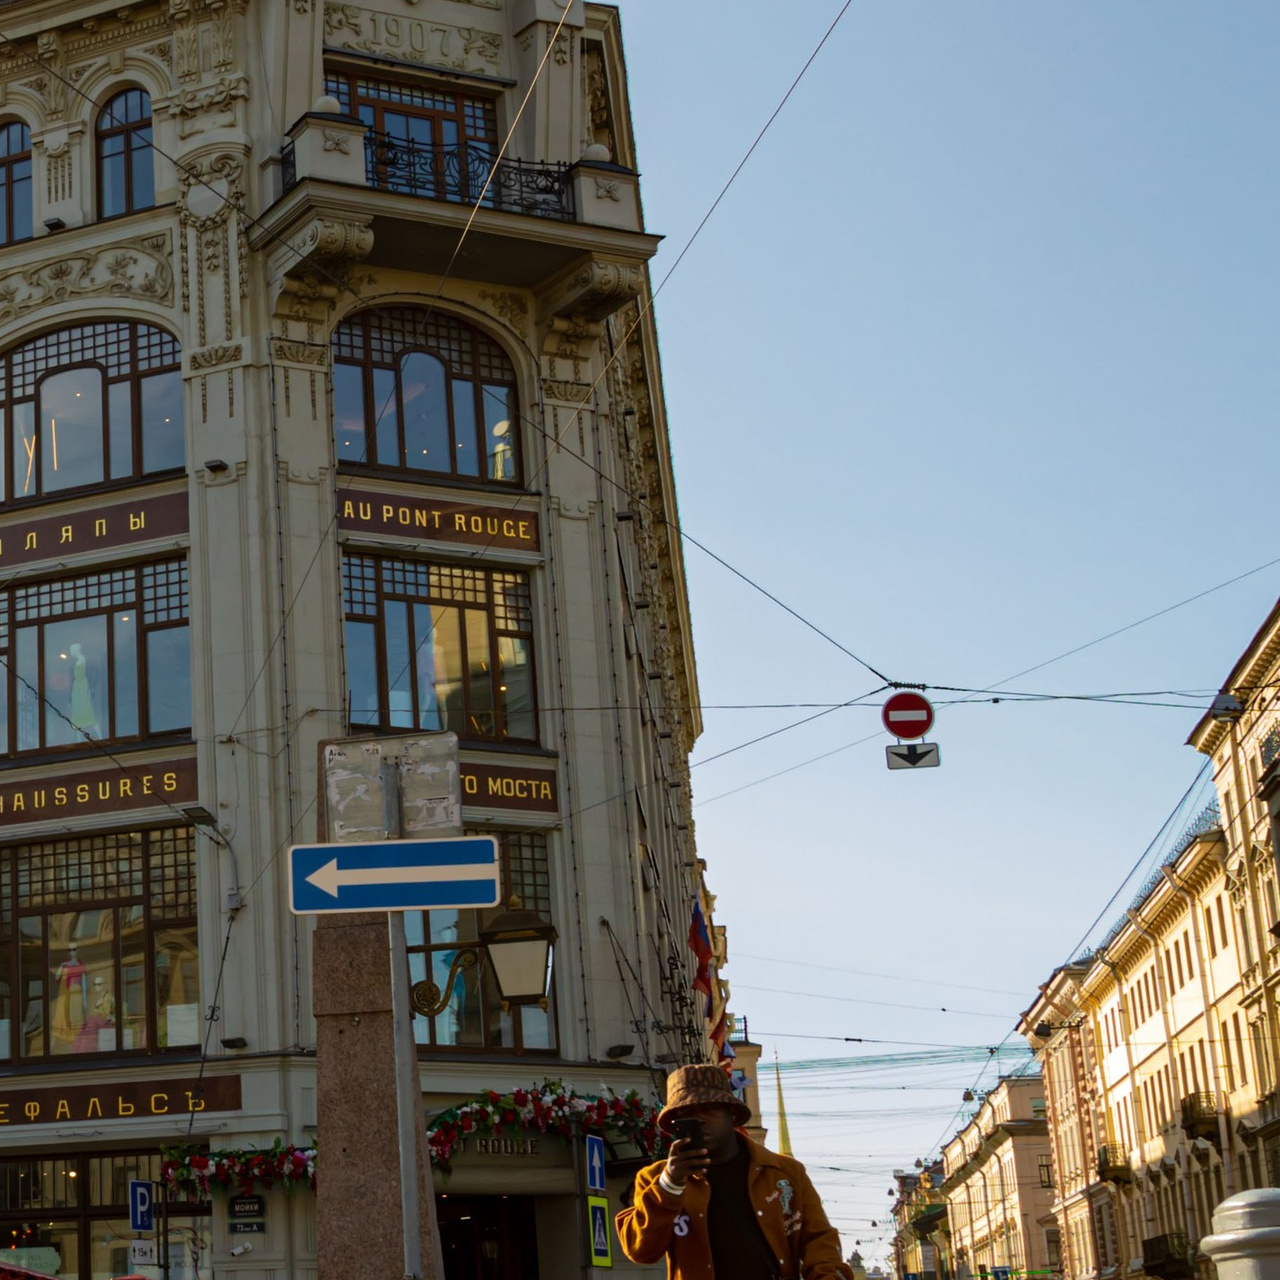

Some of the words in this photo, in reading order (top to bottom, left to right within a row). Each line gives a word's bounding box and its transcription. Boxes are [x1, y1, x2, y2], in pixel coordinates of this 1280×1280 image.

[343, 500, 372, 521] AU
[383, 504, 442, 530] PONT
[454, 513, 531, 540] ROUGE
[487, 776, 552, 800] МОСТА
[477, 1137, 540, 1155] ROUGE
[234, 1202, 259, 1212] МОЙКИ
